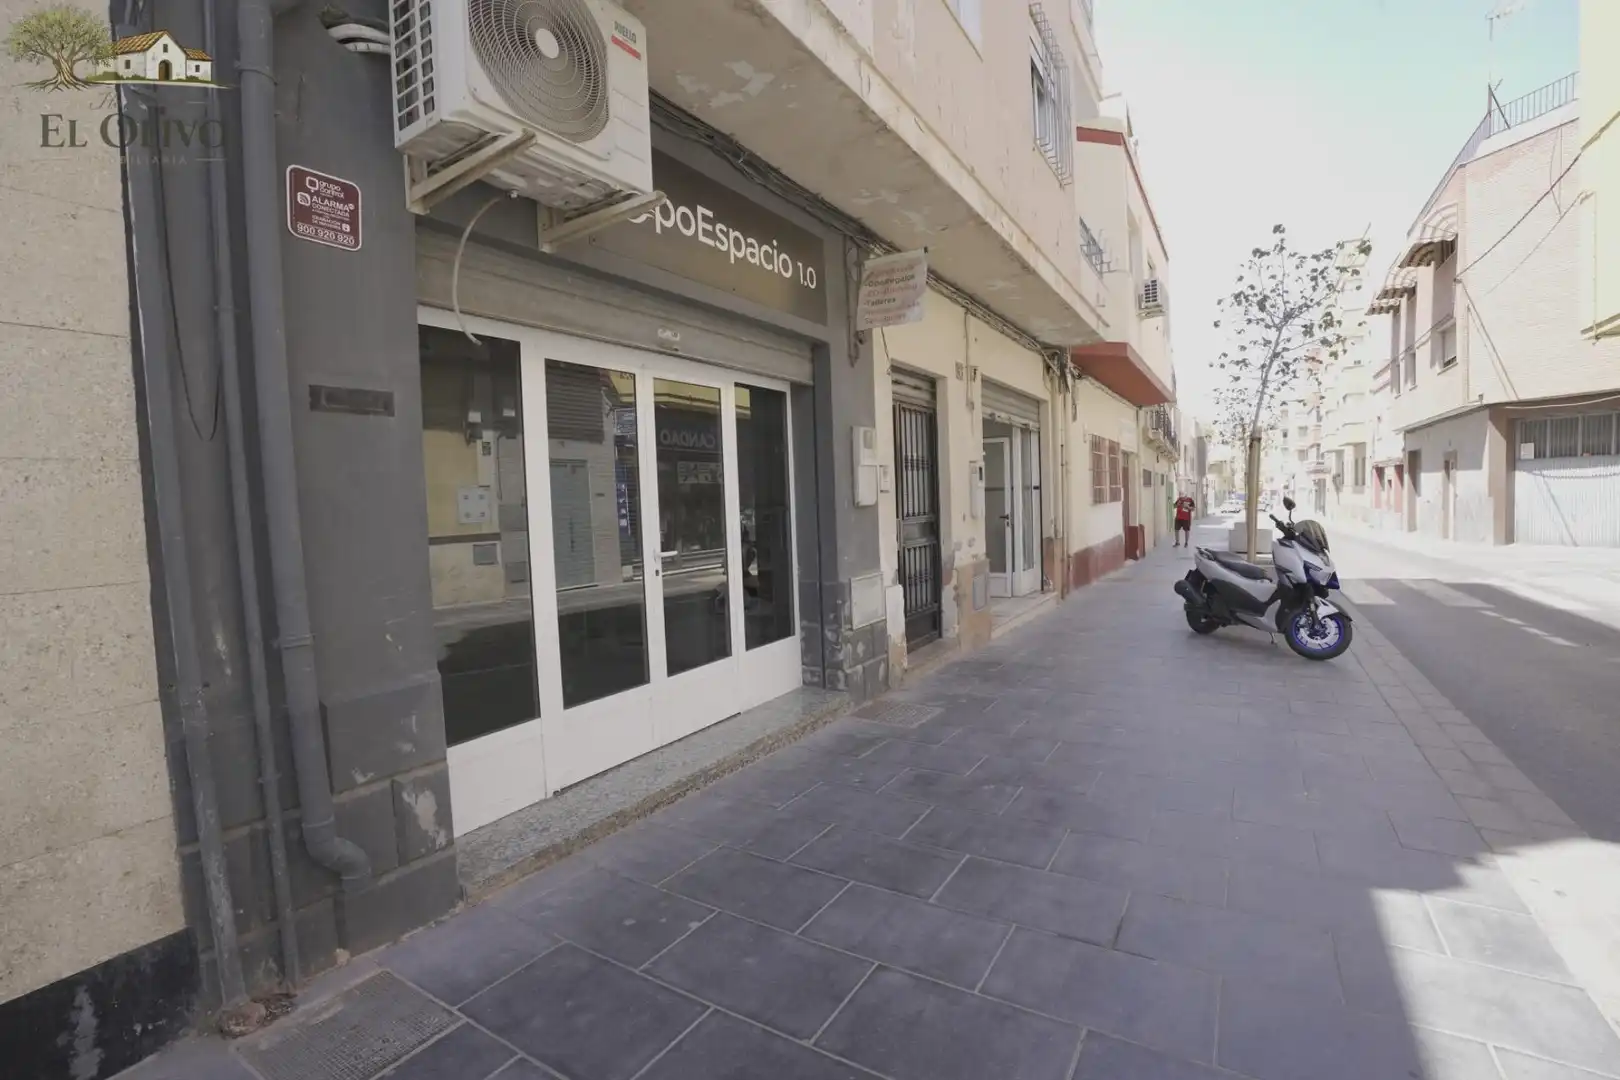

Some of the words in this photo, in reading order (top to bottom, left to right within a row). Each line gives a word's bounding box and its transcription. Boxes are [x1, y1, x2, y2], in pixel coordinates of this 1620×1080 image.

[312, 195, 350, 212] ALARMA
[296, 222, 315, 236] 900
[317, 229, 335, 240] 920
[797, 260, 817, 290] 1.0
